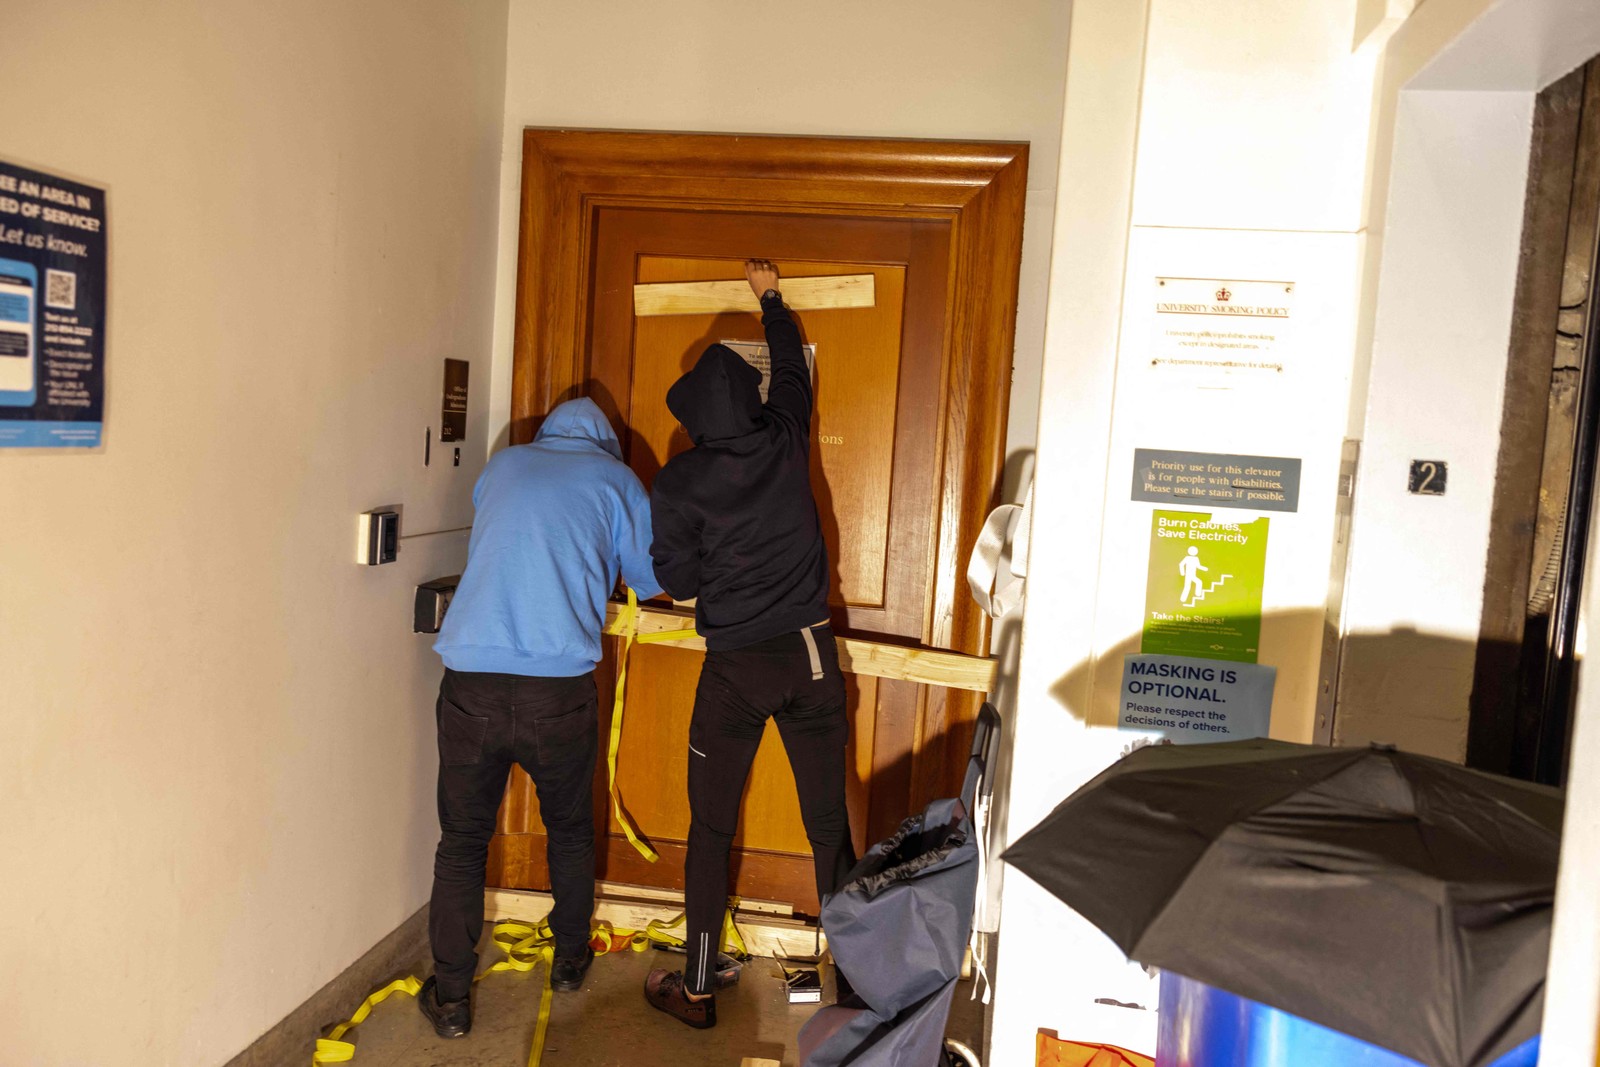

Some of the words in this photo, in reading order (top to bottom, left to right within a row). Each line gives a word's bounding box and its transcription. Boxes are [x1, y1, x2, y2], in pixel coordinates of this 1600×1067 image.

[0, 174, 17, 191] EE
[18, 180, 40, 198] AN
[41, 185, 76, 206] AREA
[76, 195, 91, 210] IN
[0, 196, 19, 214] ED
[21, 201, 41, 218] OF
[41, 206, 101, 233] SERVICE?
[25, 232, 45, 249] us
[46, 233, 88, 257] know.
[1156, 303, 1209, 312] UNIVERSITY
[1212, 305, 1254, 315] SMOKING
[1256, 307, 1290, 316] POLICY
[1151, 459, 1186, 472] Priority
[1189, 464, 1204, 472] use
[1207, 463, 1222, 473] for
[1225, 465, 1242, 475] this
[1244, 467, 1282, 477] elevator
[1148, 471, 1155, 481] is
[1159, 472, 1173, 482] for
[1176, 474, 1206, 485] people
[1209, 476, 1229, 486] with
[1232, 477, 1283, 489] disabilities.
[1419, 462, 1436, 493] 2
[1144, 483, 1171, 494] Please
[1191, 485, 1206, 496] the
[1209, 487, 1232, 498] stairs
[1236, 488, 1243, 498] if
[1247, 490, 1286, 501] possible.
[1158, 517, 1187, 528] Burn
[1189, 519, 1242, 532] Calories,
[1157, 528, 1186, 539] Save
[1188, 530, 1248, 545] Electricity
[1151, 611, 1174, 621] Take
[1176, 614, 1191, 623] the
[1193, 616, 1225, 625] Stairs!
[1130, 662, 1215, 681] MASKING
[1220, 670, 1237, 684] IS
[1127, 680, 1226, 703] OPTIONAL.
[1126, 702, 1162, 714] Please
[1164, 707, 1205, 719] respect
[1208, 711, 1226, 721] the
[1125, 715, 1176, 728] decisions
[1178, 720, 1190, 729] of
[1192, 722, 1230, 733] others.
